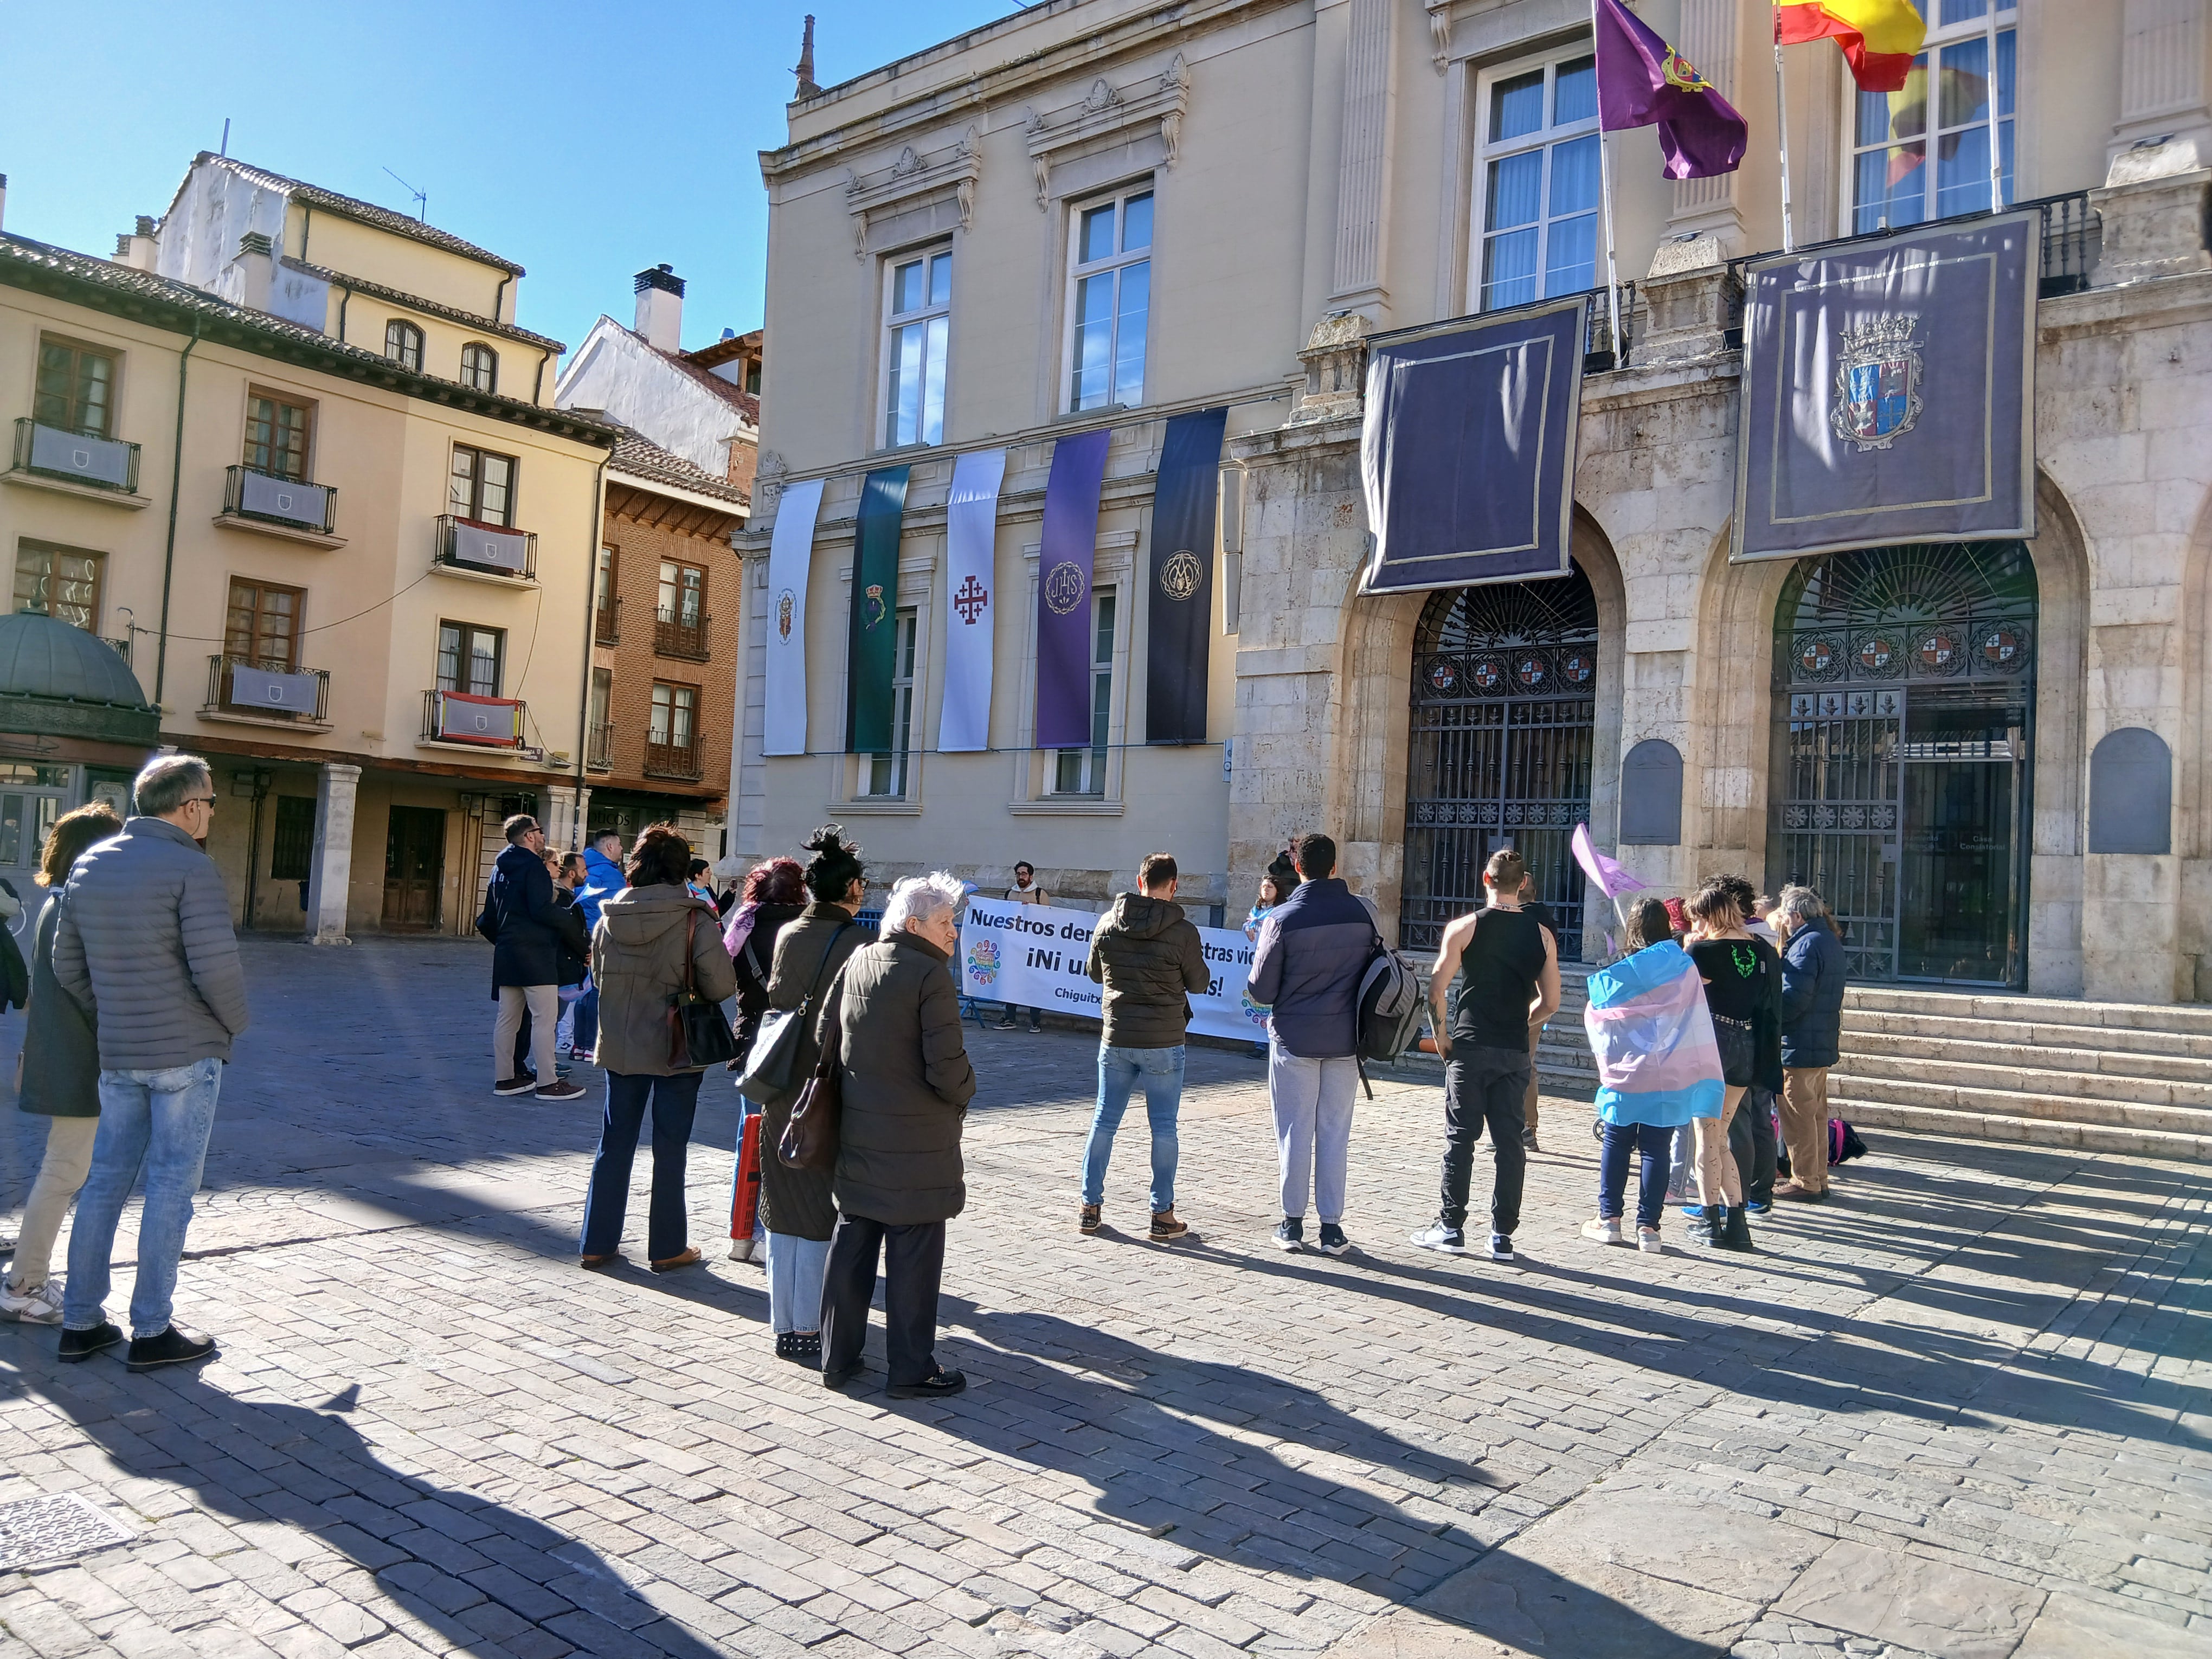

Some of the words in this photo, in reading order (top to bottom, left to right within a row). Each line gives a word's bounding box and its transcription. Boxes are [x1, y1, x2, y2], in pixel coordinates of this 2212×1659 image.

[970, 909, 1055, 937] Nuestros
[1060, 923, 1094, 942] der
[1201, 942, 1233, 963] tras
[1054, 987, 1102, 1005] Chiguitx
